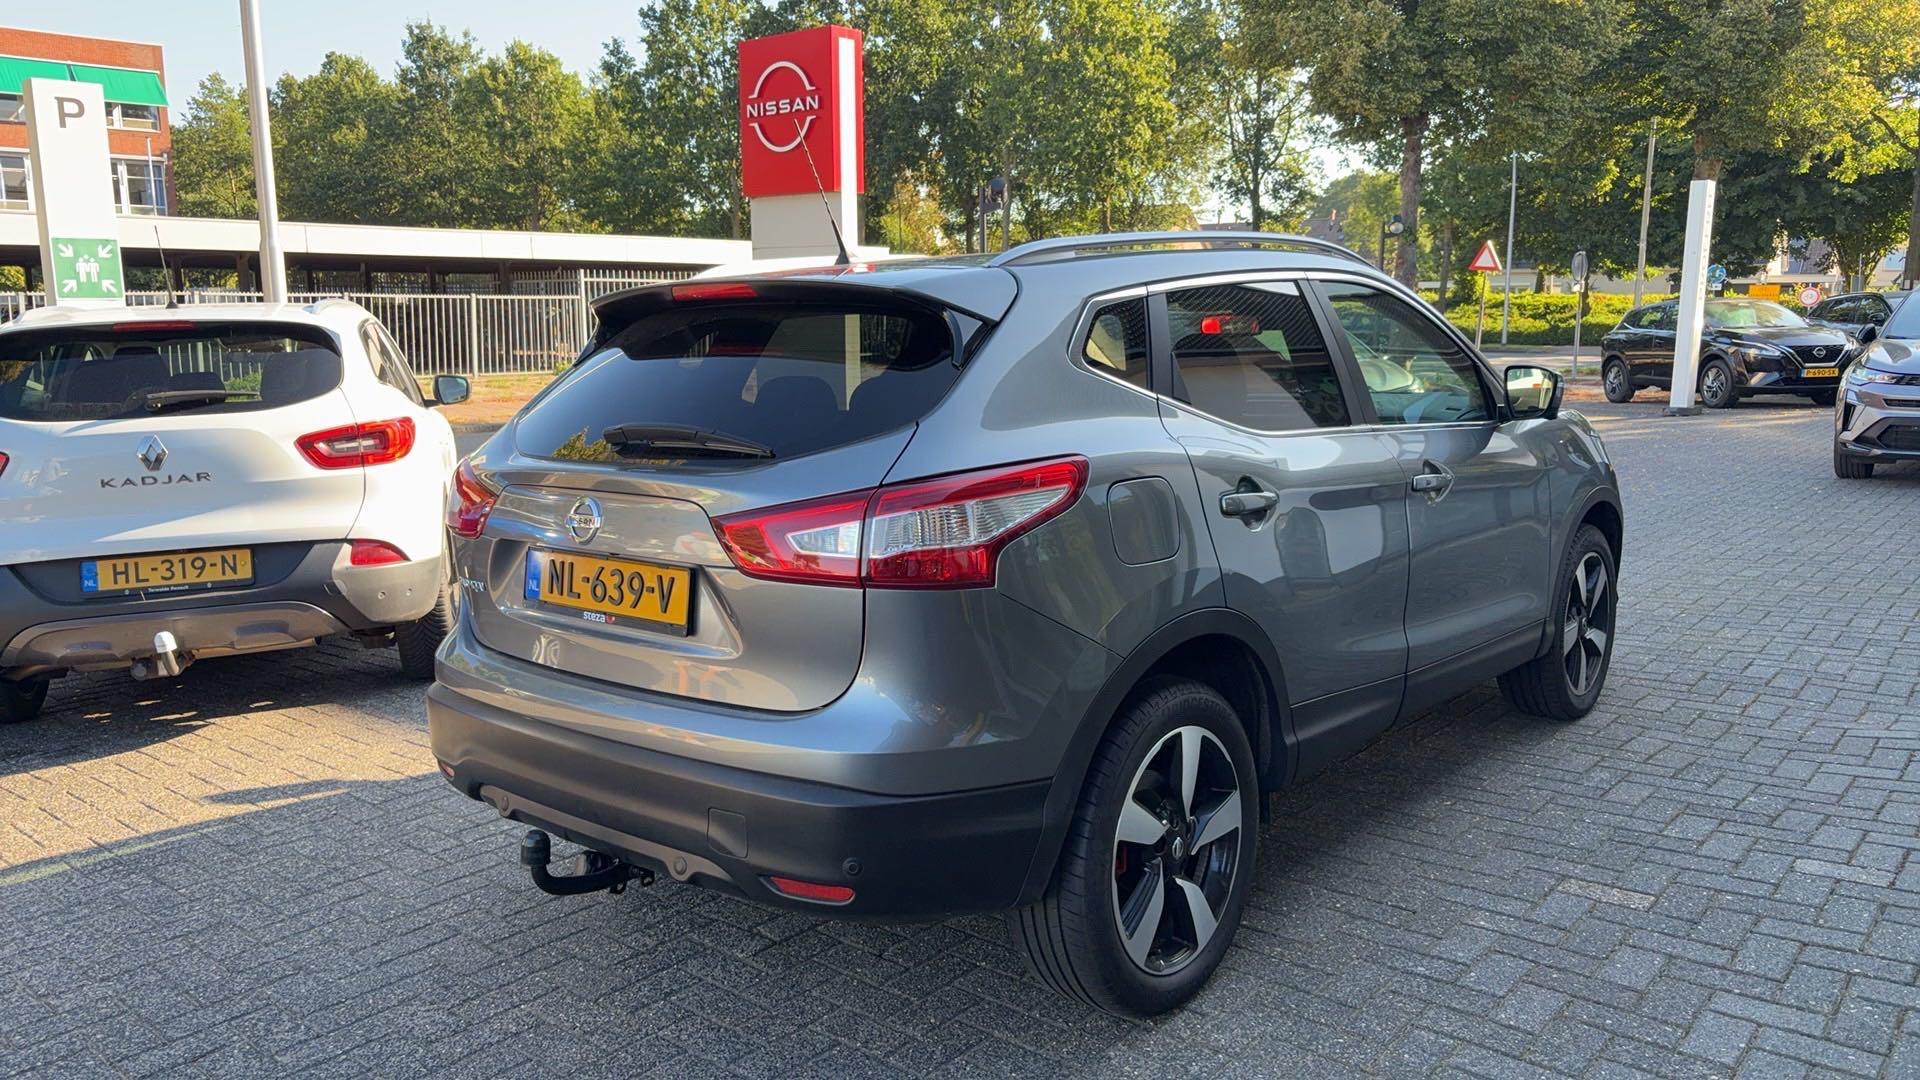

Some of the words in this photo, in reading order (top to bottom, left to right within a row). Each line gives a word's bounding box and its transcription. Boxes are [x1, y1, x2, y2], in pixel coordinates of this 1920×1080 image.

[54, 96, 85, 129] P
[746, 95, 820, 118] NISSAN
[100, 472, 212, 488] KADJAR
[111, 553, 238, 585] HL-319-N
[84, 579, 97, 587] NL
[527, 579, 540, 591] NL
[548, 558, 675, 614] NL-639-V
[583, 611, 606, 623] steza
